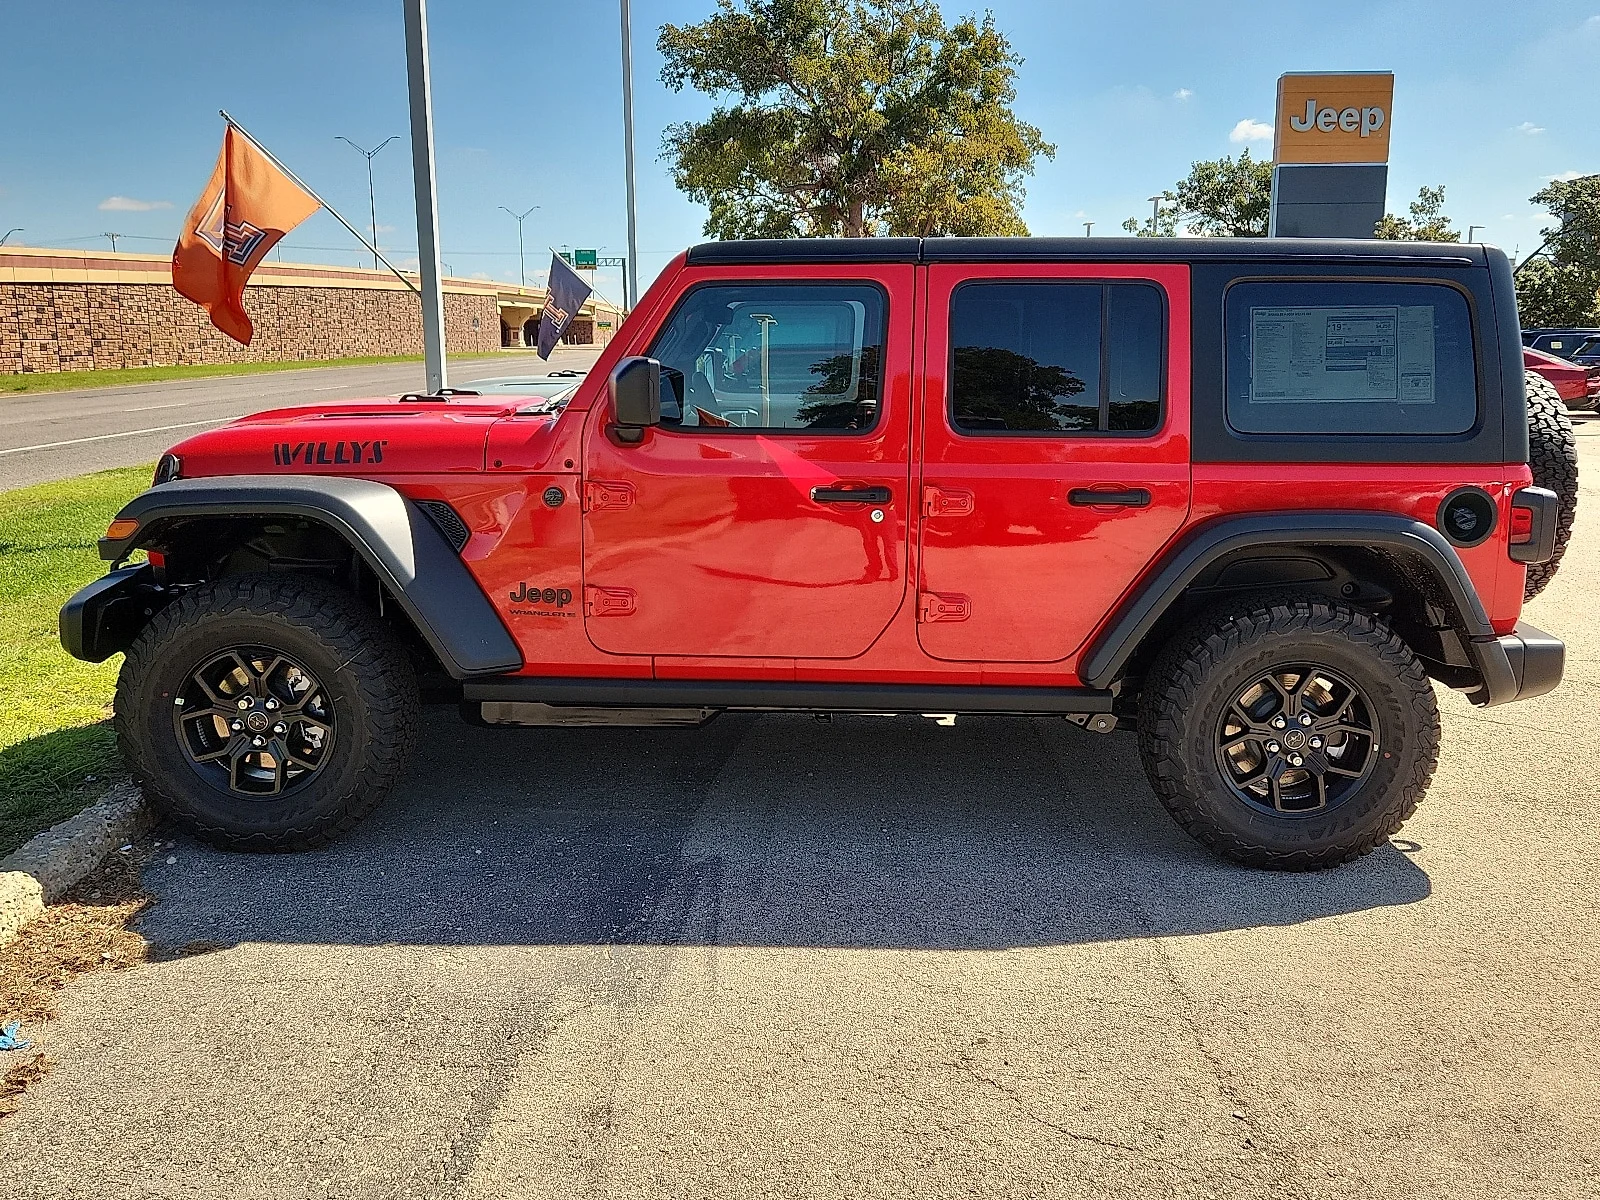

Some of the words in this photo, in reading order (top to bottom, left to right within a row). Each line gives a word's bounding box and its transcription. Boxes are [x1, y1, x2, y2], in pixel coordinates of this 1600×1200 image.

[1290, 99, 1385, 138] Jeep
[1332, 323, 1342, 331] 19
[273, 440, 388, 466] WILLYS
[509, 582, 572, 608] Jeep
[509, 609, 566, 618] WRANGLER
